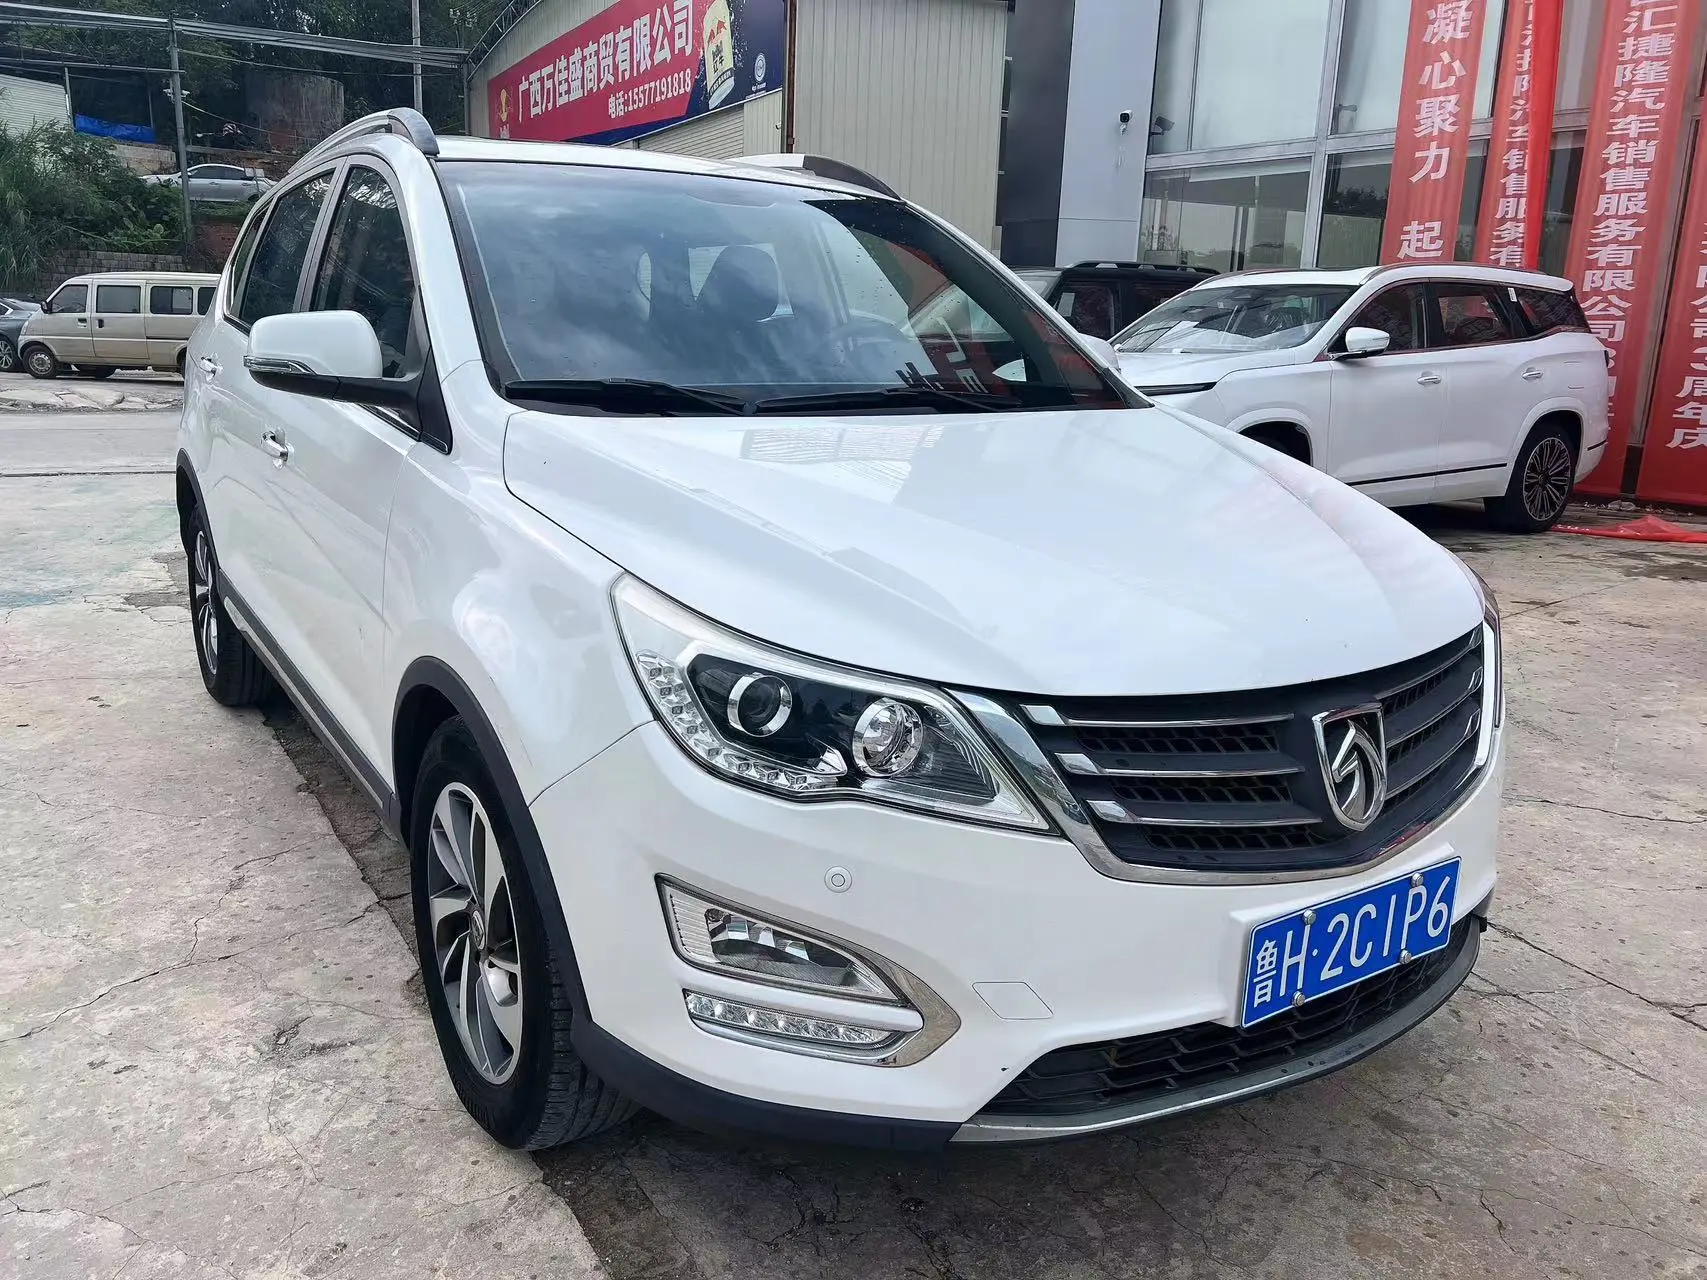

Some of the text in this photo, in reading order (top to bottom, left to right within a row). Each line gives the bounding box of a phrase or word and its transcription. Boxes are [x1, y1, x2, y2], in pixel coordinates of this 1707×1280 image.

[518, 0, 693, 123] 广西万佳盛商贸有限公司
[1397, 0, 1474, 260] 凝心聚力 起
